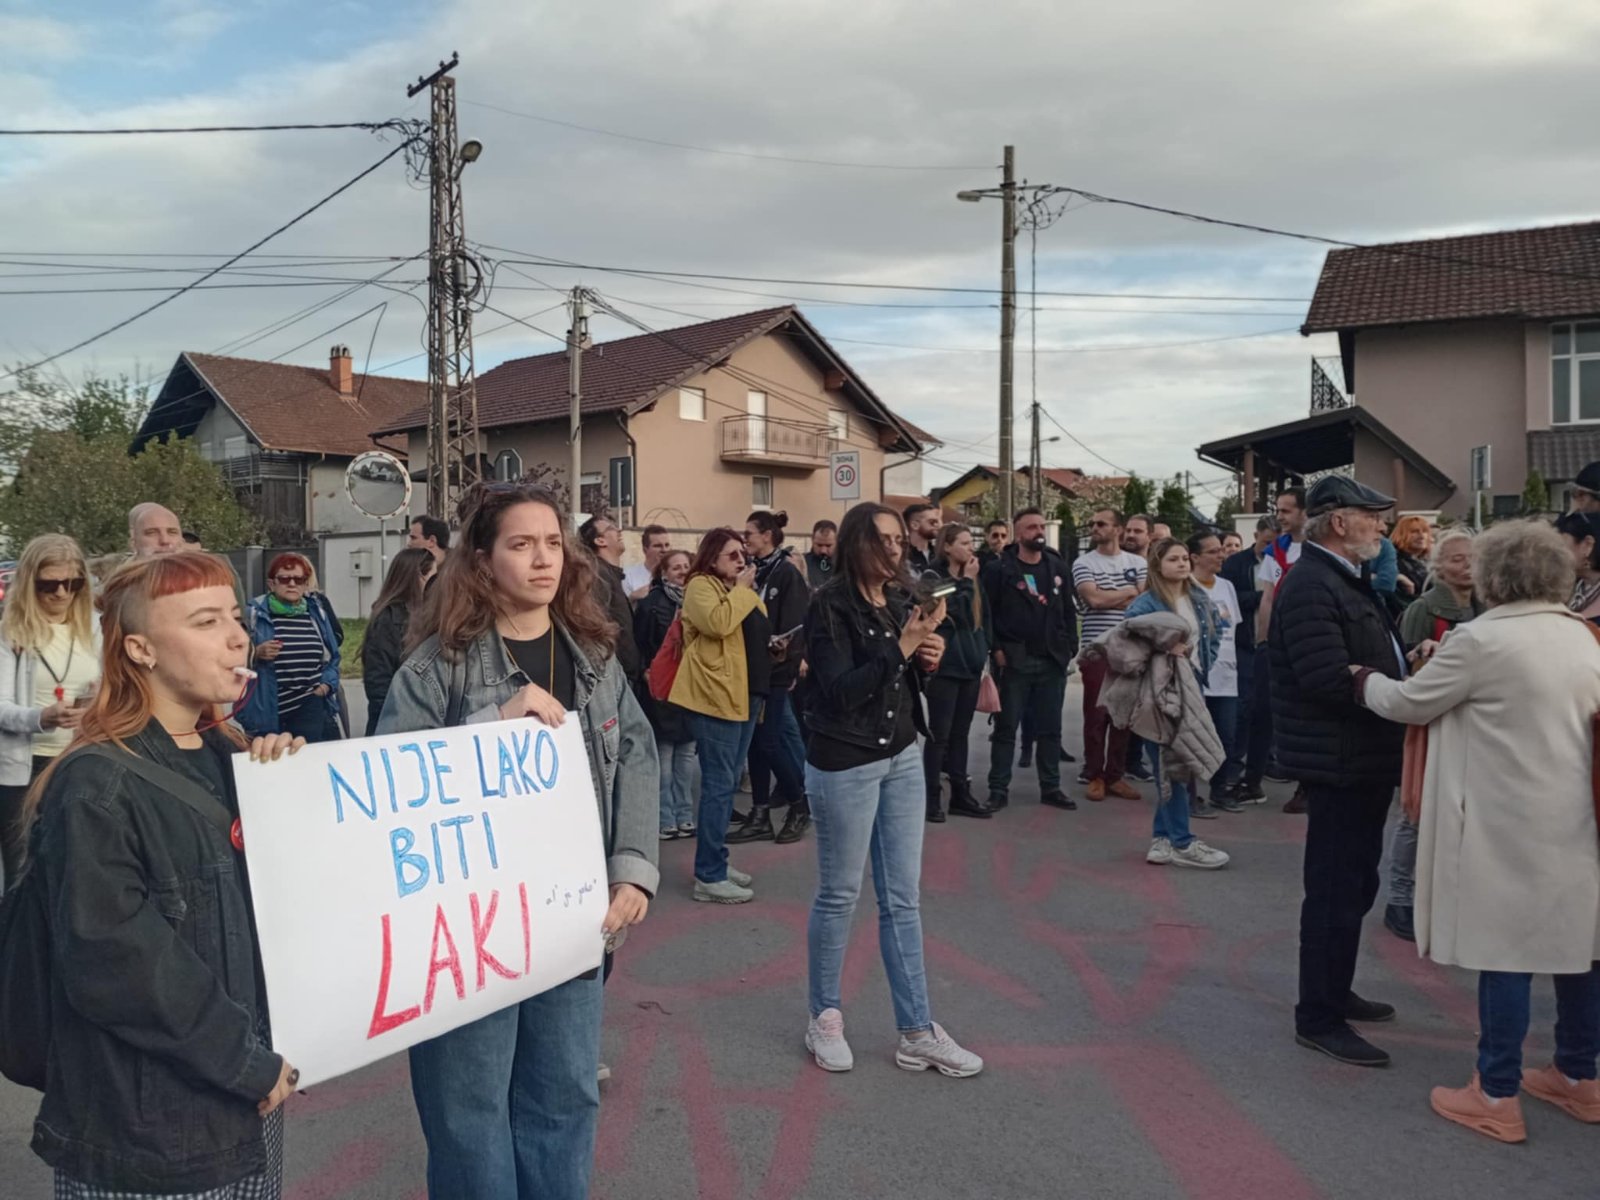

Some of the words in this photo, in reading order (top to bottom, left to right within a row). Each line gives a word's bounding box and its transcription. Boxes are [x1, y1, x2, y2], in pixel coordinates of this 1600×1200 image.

[839, 470, 851, 481] 30
[327, 740, 460, 824] NIJE
[473, 730, 558, 798] LAKO
[389, 811, 499, 899] BITI
[366, 881, 531, 1040] LAKI
